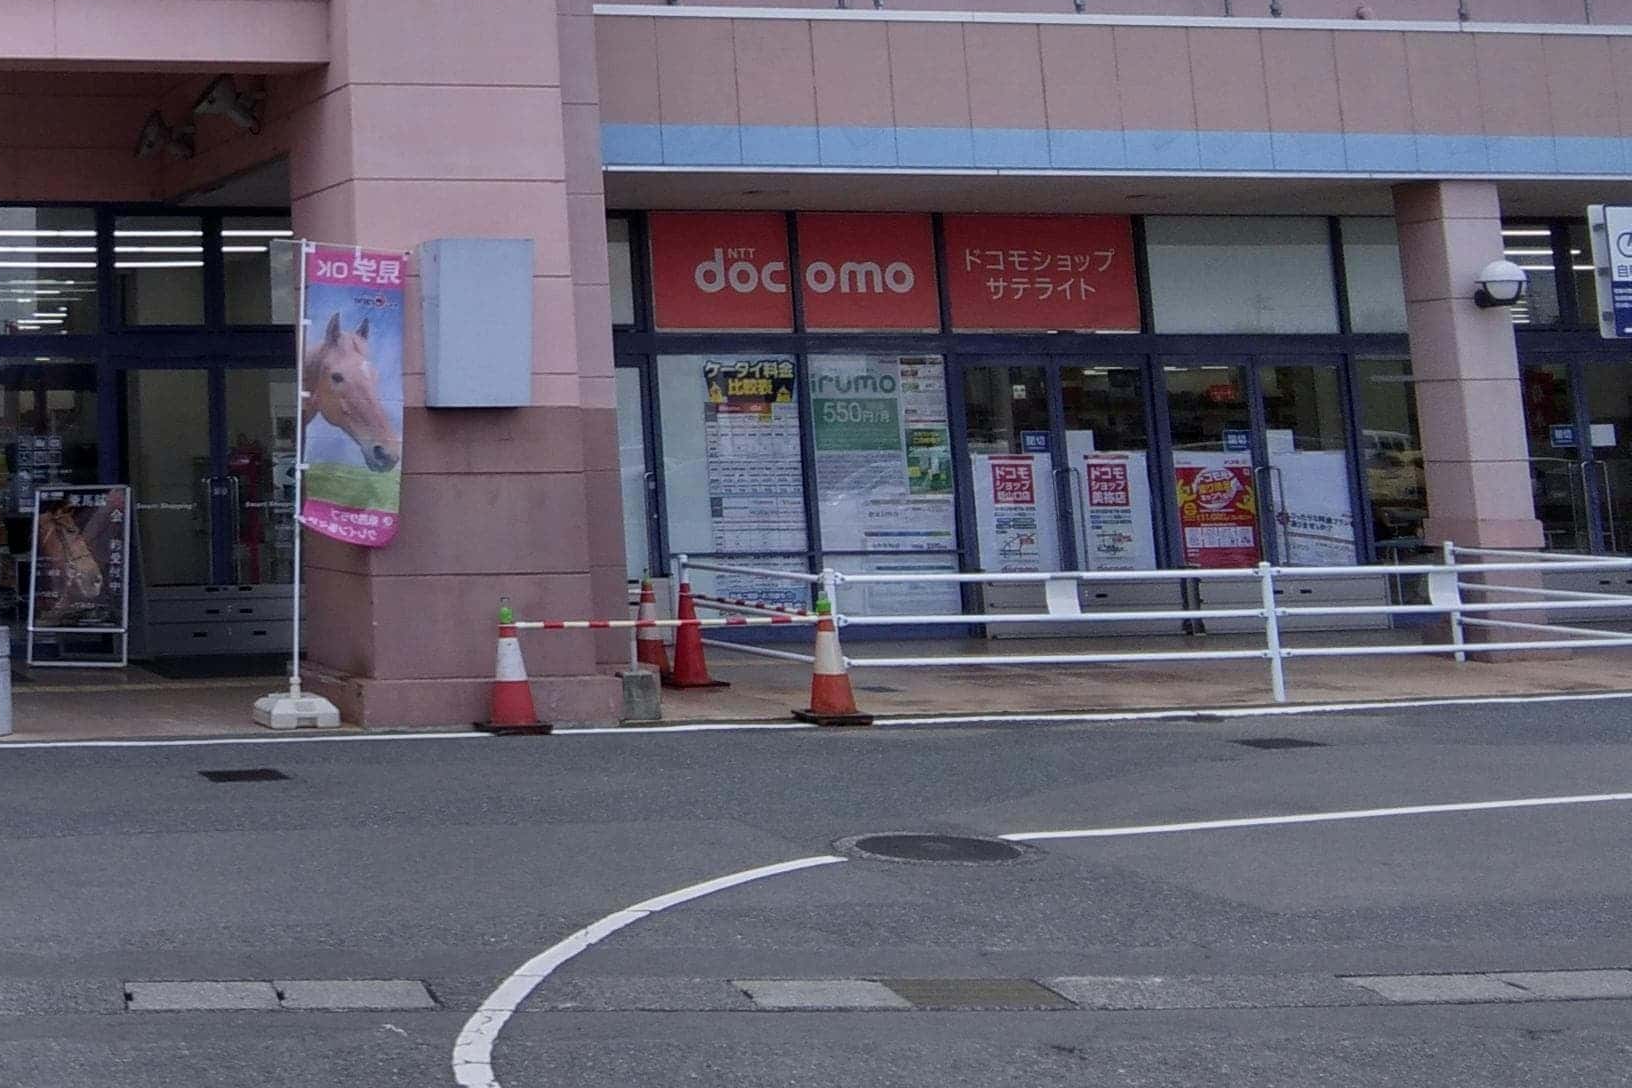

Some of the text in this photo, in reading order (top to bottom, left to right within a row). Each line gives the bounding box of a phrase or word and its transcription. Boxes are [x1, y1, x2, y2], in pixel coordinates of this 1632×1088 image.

[727, 247, 756, 259] NTT
[965, 247, 1115, 274] ドコモショップ
[985, 277, 1097, 301] サテライト
[704, 361, 794, 379] ケータイ料金
[810, 373, 896, 394] irumo
[995, 466, 1030, 479] ドコモ
[1090, 466, 1125, 480] ドコモ
[996, 479, 1031, 491] ショップ
[1091, 480, 1126, 492] ショップ
